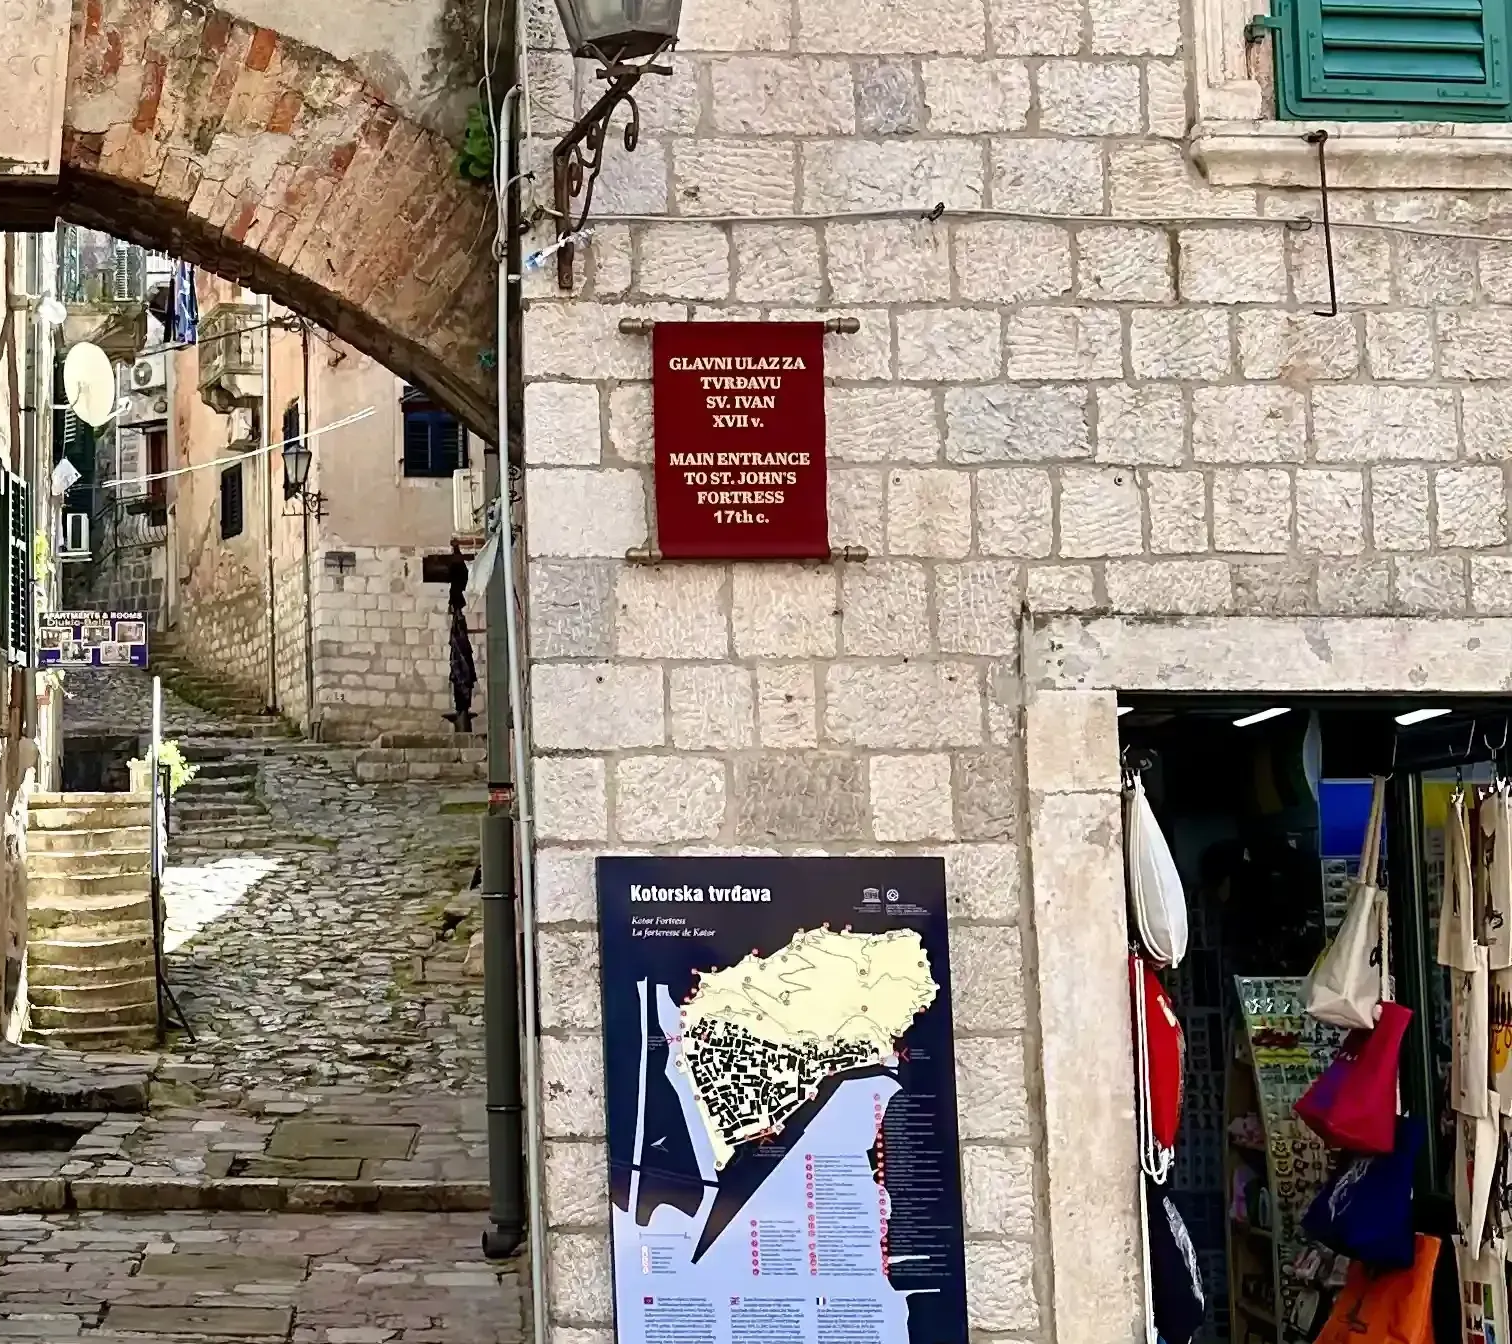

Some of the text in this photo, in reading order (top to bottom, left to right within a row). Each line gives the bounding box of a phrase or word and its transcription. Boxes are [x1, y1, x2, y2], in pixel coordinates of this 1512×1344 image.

[669, 357, 806, 371] GLAVNI ULAZ ZA
[699, 376, 782, 390] TVRĐAVU
[705, 395, 776, 409] SV. IVAN
[712, 414, 765, 428] XVII v.
[669, 452, 811, 466] MAIN ENTRANCE
[683, 471, 797, 485] TO ST. JOHN'S
[697, 490, 785, 505] FORTRESS
[713, 509, 770, 524] 17th c.
[630, 884, 772, 902] Kotorska tvrđava
[631, 915, 686, 925] Kotor Fortress
[631, 927, 643, 937] La
[692, 927, 716, 937] Kotor
